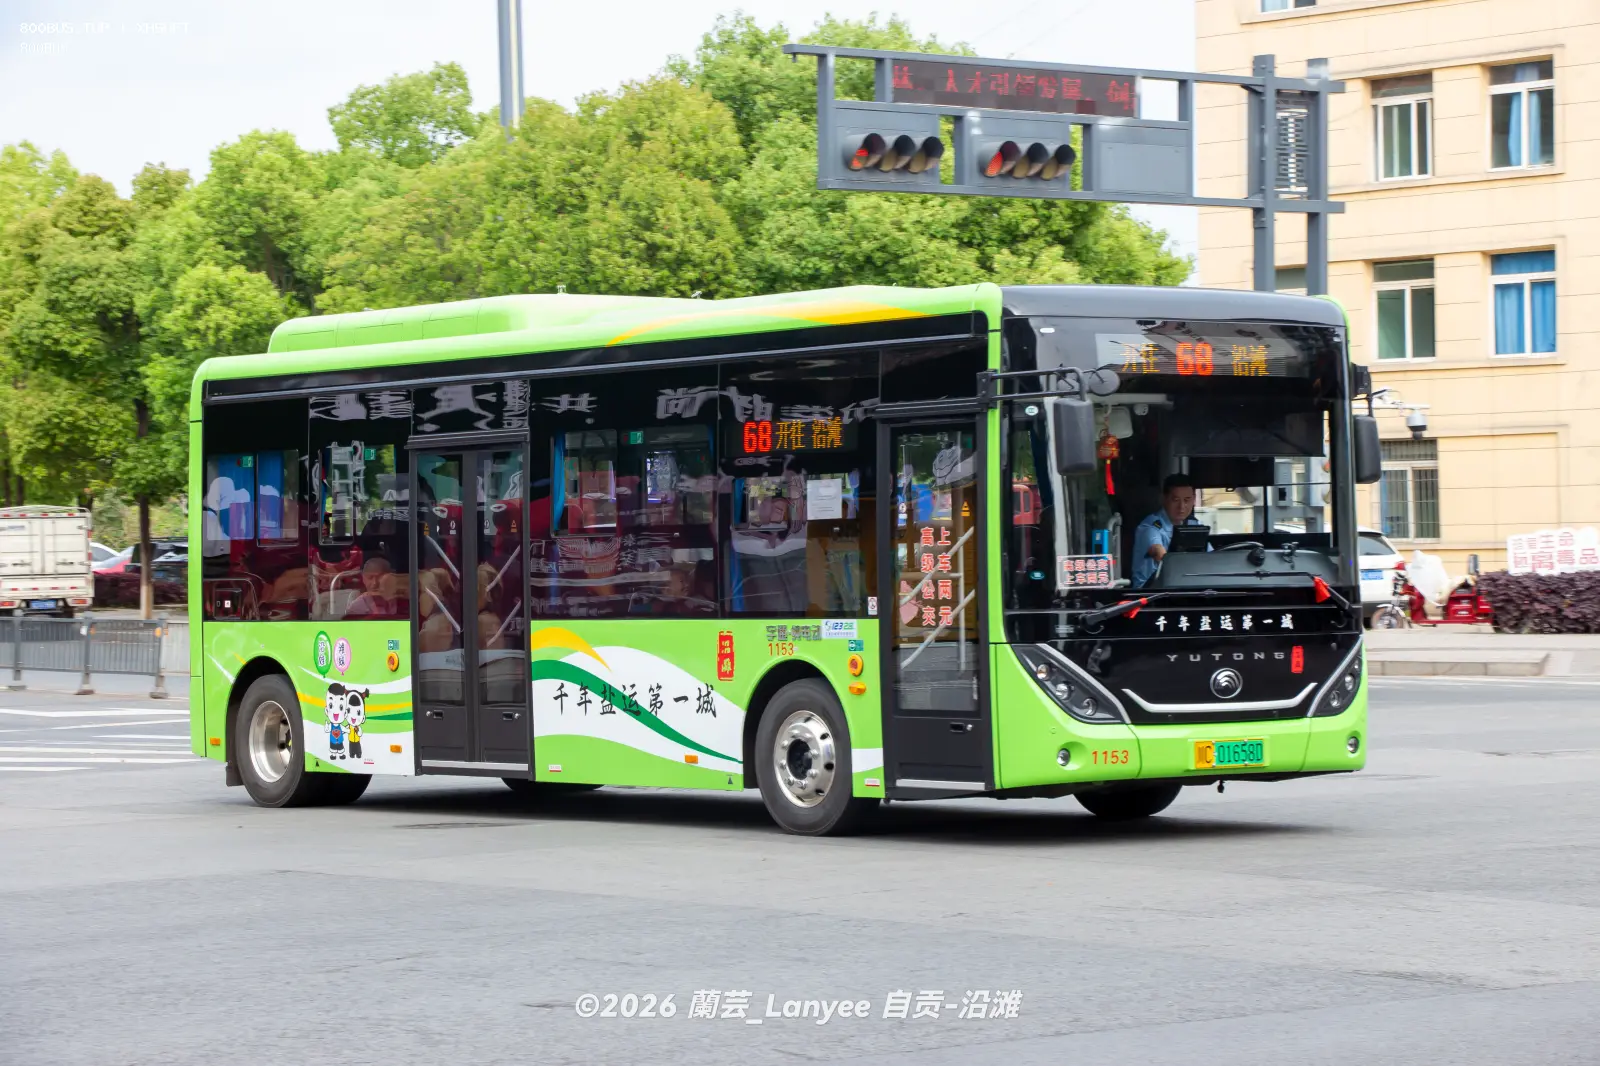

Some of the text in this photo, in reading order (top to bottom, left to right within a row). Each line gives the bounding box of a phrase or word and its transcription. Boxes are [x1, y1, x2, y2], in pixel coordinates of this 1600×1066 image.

[1120, 342, 1270, 376] 开往 68 沿滩
[743, 416, 843, 453] 68 开往 沿滩
[920, 527, 936, 626] 高级公交
[937, 527, 953, 626] 上车两元
[1155, 613, 1294, 632] 千年盐运第一城
[768, 642, 794, 656] 1153
[1166, 652, 1285, 662] YUTONG
[552, 682, 717, 718] 千年盐运第一城
[1092, 750, 1129, 764] 1153
